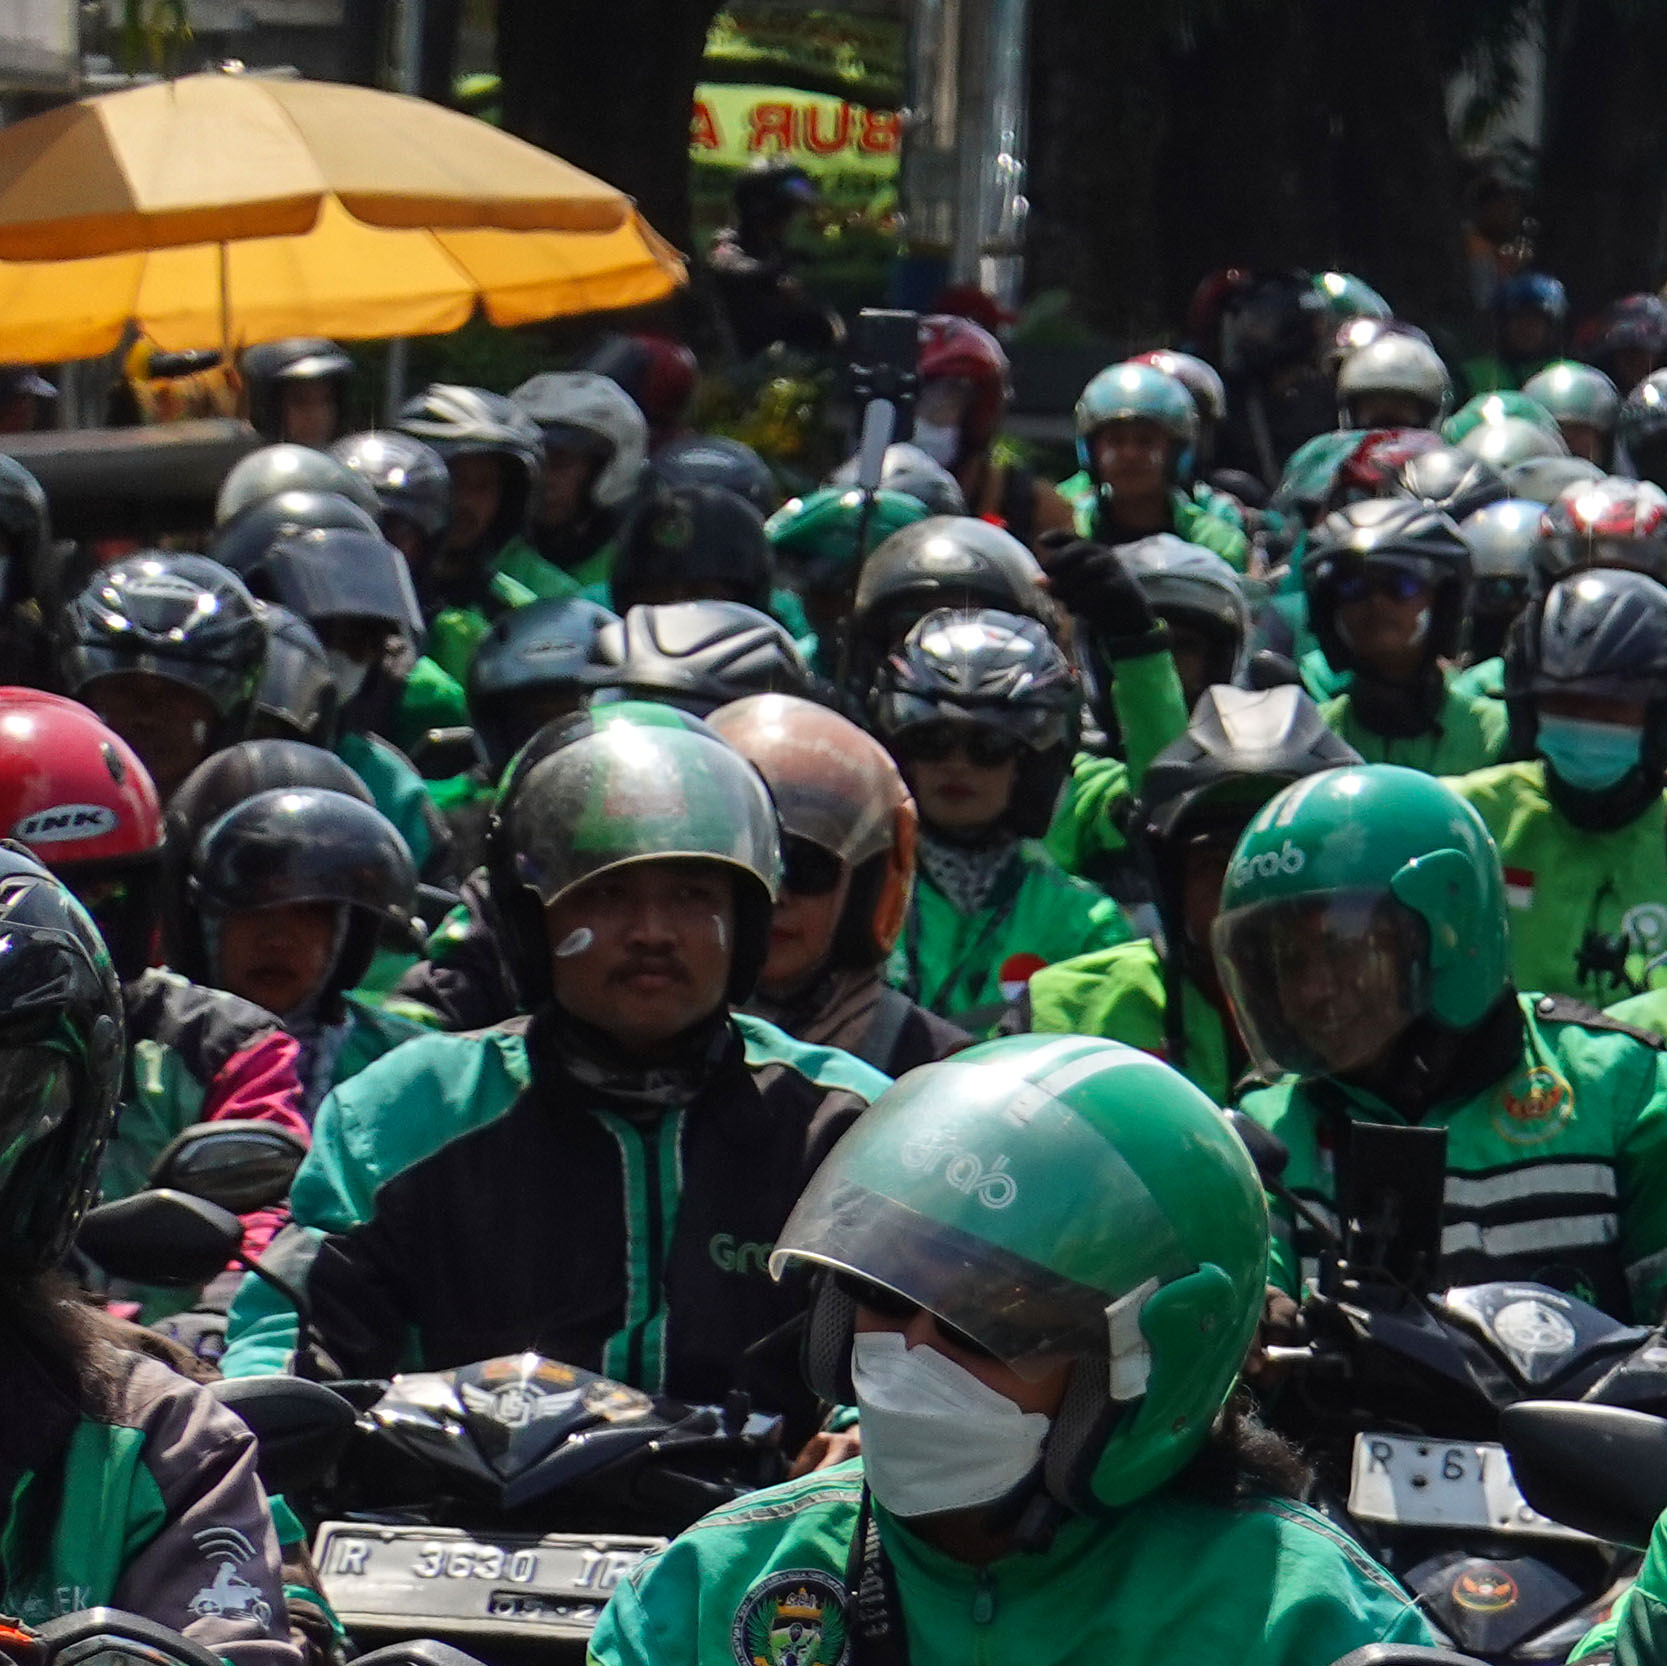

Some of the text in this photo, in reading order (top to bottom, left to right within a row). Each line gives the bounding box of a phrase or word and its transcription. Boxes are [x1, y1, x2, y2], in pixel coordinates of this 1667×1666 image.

[25, 809, 103, 834] INK
[1232, 838, 1305, 888] Grab
[900, 1140, 1019, 1210] Grab
[1369, 1441, 1393, 1475] R
[337, 1539, 371, 1575] R
[413, 1541, 538, 1583] 3630
